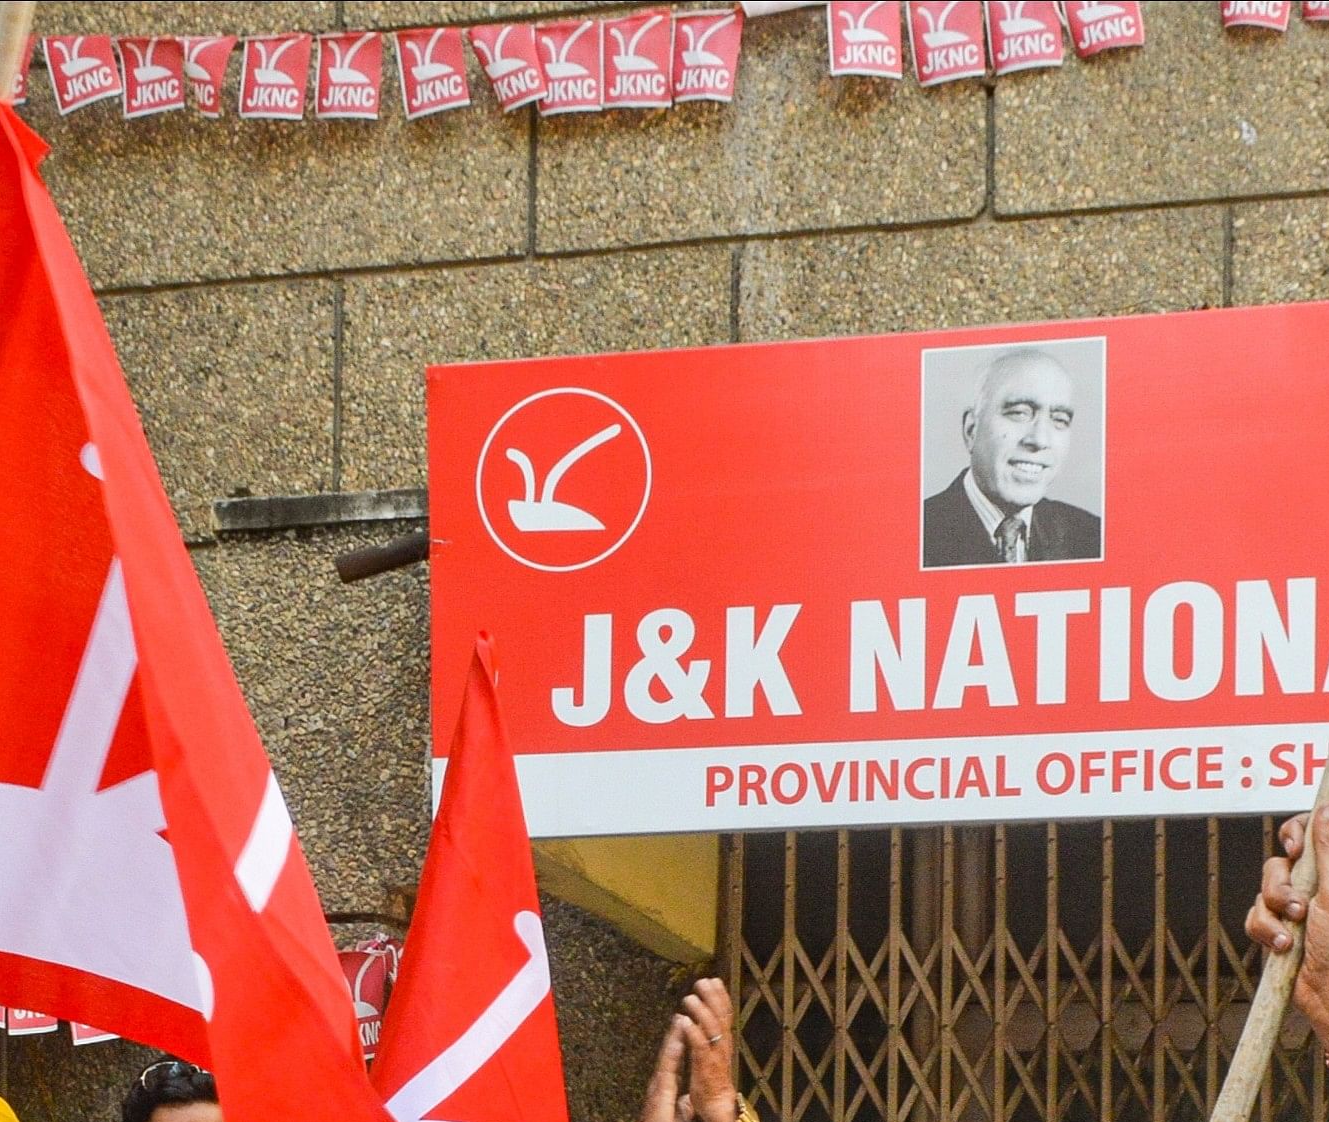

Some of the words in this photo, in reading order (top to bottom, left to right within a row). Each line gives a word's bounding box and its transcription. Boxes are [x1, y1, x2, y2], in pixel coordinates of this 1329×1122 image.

[1079, 15, 1136, 48] JKNC
[840, 44, 897, 66] JKNC
[922, 44, 979, 74] JKNC
[997, 33, 1055, 62] JKNC
[63, 68, 113, 101] JKNC
[131, 80, 180, 107] JKNC
[411, 75, 463, 106] JKNC
[544, 78, 597, 103] JKNC
[609, 73, 666, 97] JKNC
[675, 68, 729, 91] JKNC
[246, 86, 299, 108] JKNC
[322, 86, 376, 107] JKNC
[551, 603, 802, 727] J&K
[706, 757, 1021, 807] PROVINCIAL
[1036, 748, 1223, 795] OFFICE
